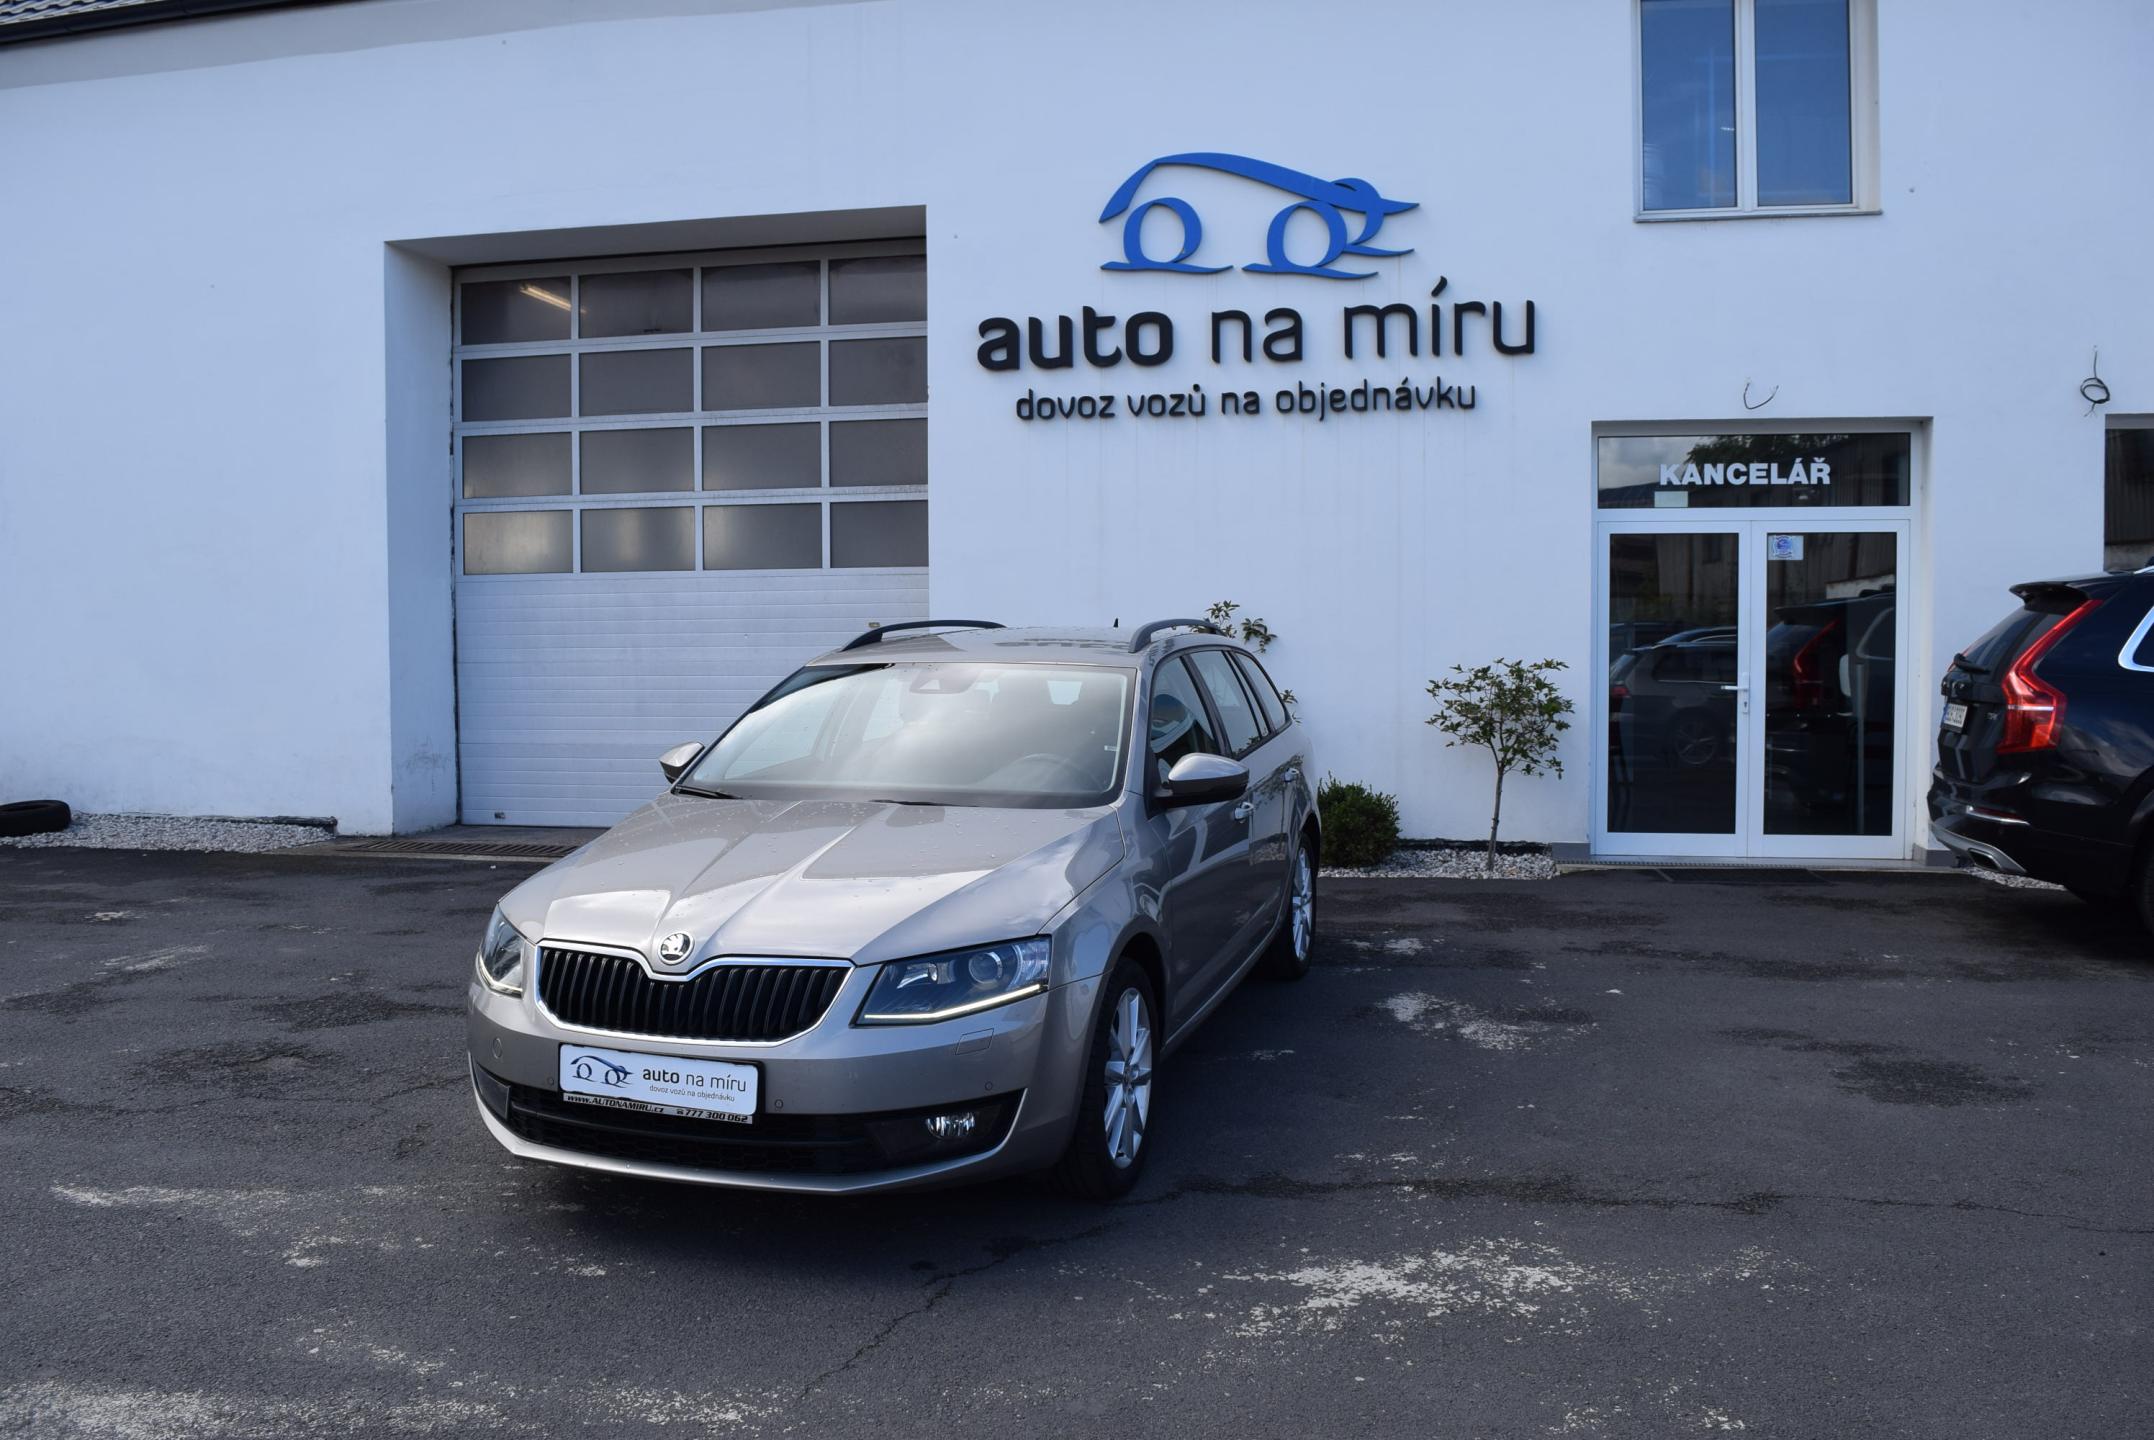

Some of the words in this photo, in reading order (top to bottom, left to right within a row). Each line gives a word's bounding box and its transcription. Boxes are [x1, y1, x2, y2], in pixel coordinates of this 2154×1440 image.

[977, 305, 1174, 373] auto
[1211, 307, 1304, 365] na
[1343, 275, 1536, 360] míru
[1016, 388, 1116, 421] dovoz
[1127, 383, 1206, 418] vozů
[1221, 391, 1261, 416] na
[1275, 376, 1477, 422] objednávku
[1659, 457, 1831, 485] KANCELÁŘ
[643, 1068, 680, 1084] auto
[686, 1074, 704, 1087] na
[710, 1074, 746, 1092] míru
[649, 1084, 669, 1094] dovoz
[669, 1087, 686, 1096] vozů
[697, 1091, 735, 1102] objednávku
[685, 1107, 703, 1116] 777
[705, 1111, 725, 1120] 300
[727, 1114, 748, 1123] 062
